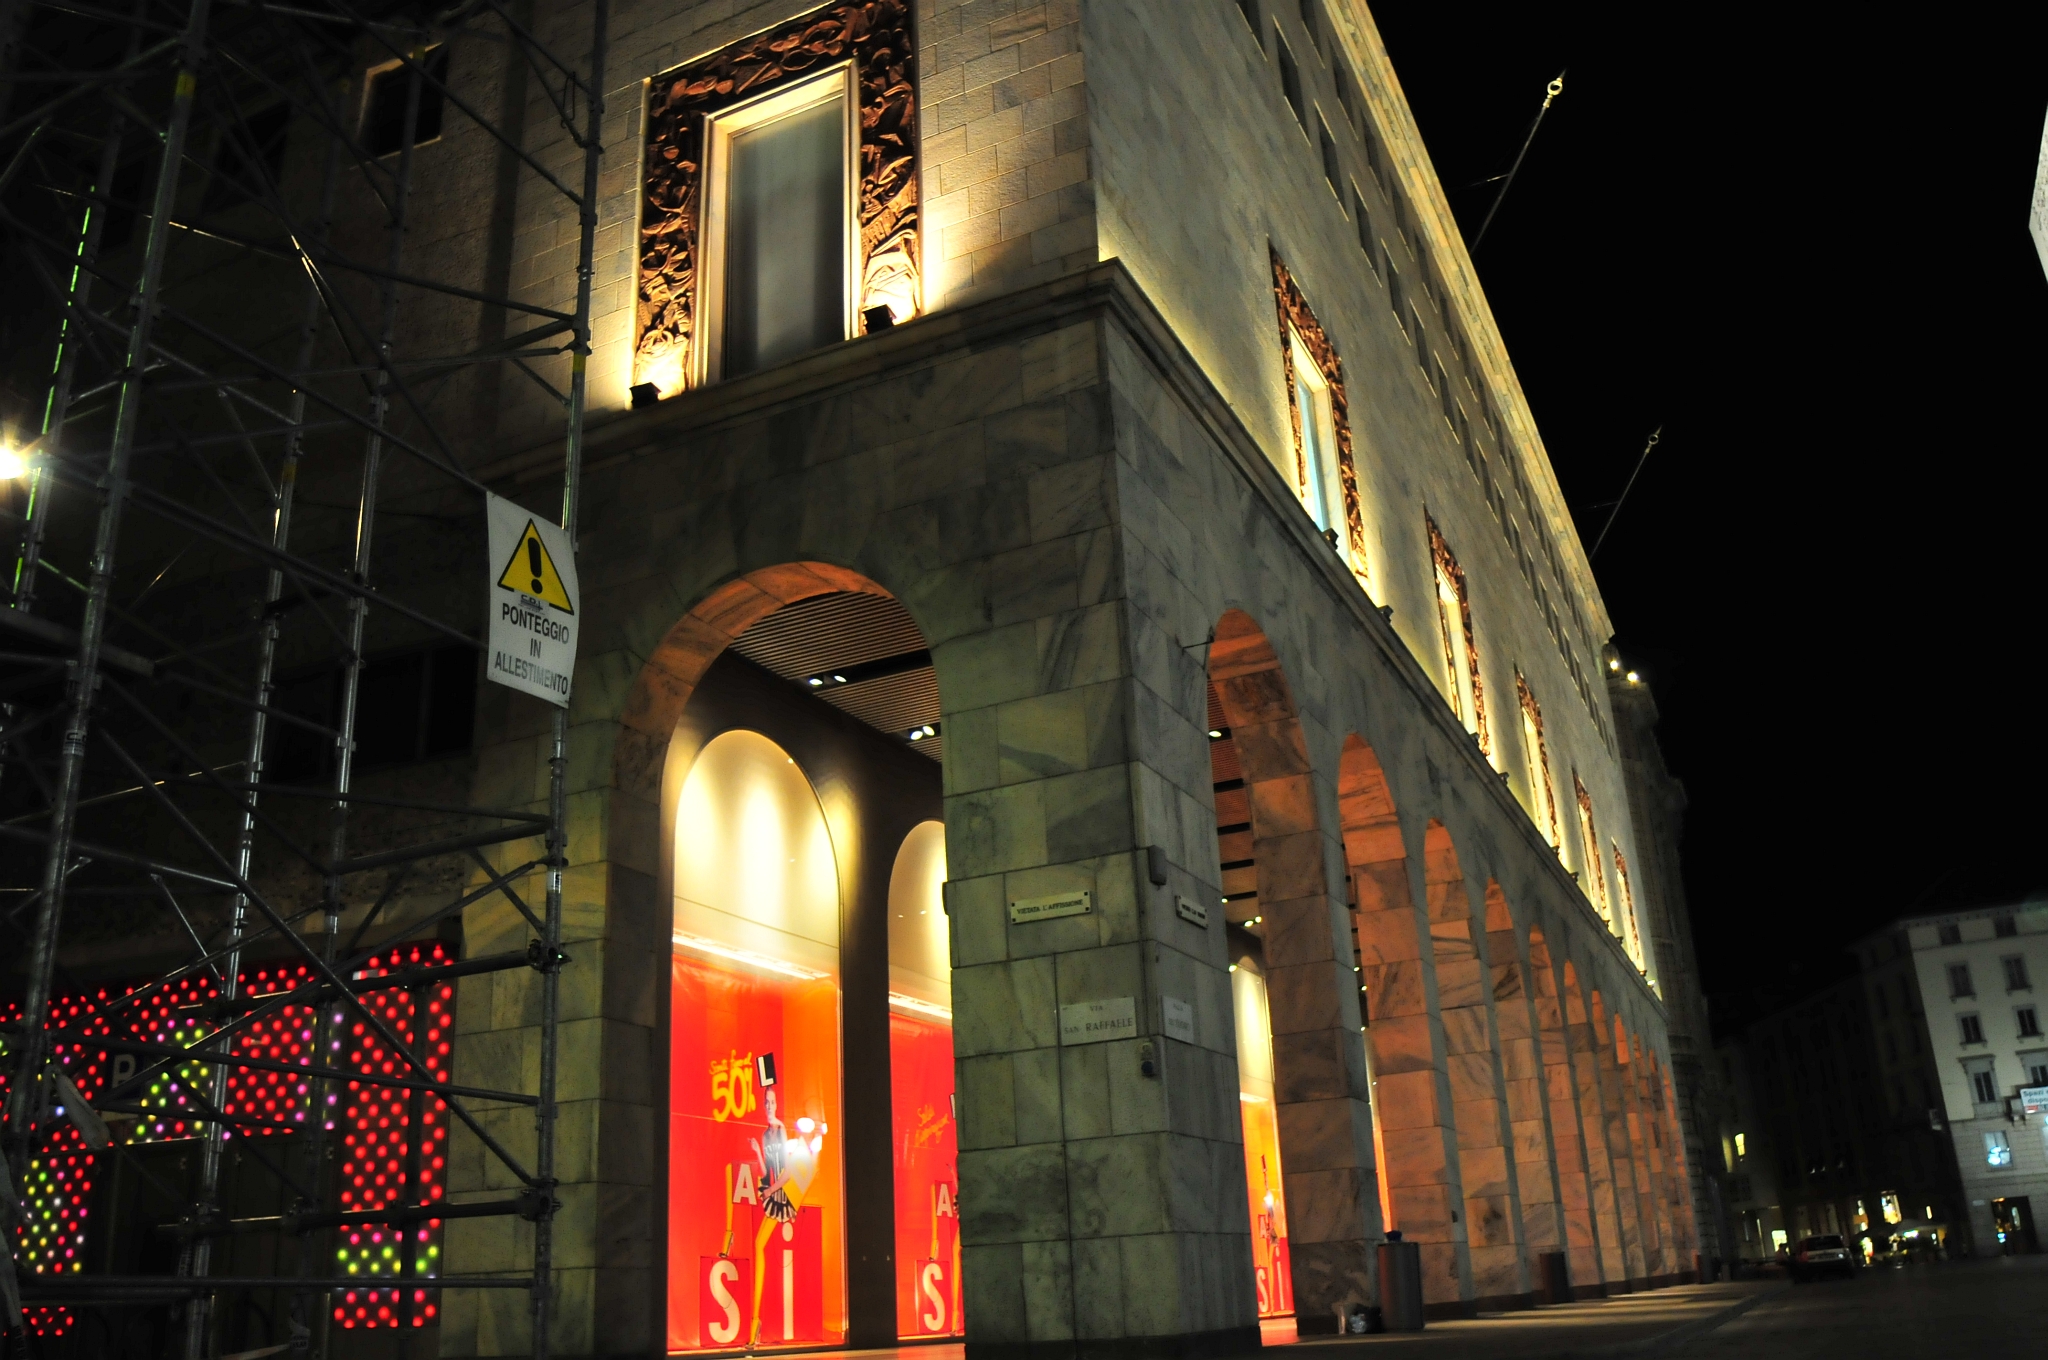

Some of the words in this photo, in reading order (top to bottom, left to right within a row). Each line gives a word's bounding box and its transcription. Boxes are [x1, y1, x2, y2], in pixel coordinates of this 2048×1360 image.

[502, 602, 570, 645] PONTEGGIO
[530, 638, 541, 659] IN
[494, 651, 569, 696] ALLESTIMENTO
[1017, 906, 1040, 915] VIETATA
[1064, 1026, 1079, 1035] SAN
[1085, 1017, 1133, 1032] RAFFAELE
[712, 1067, 756, 1122] 50%
